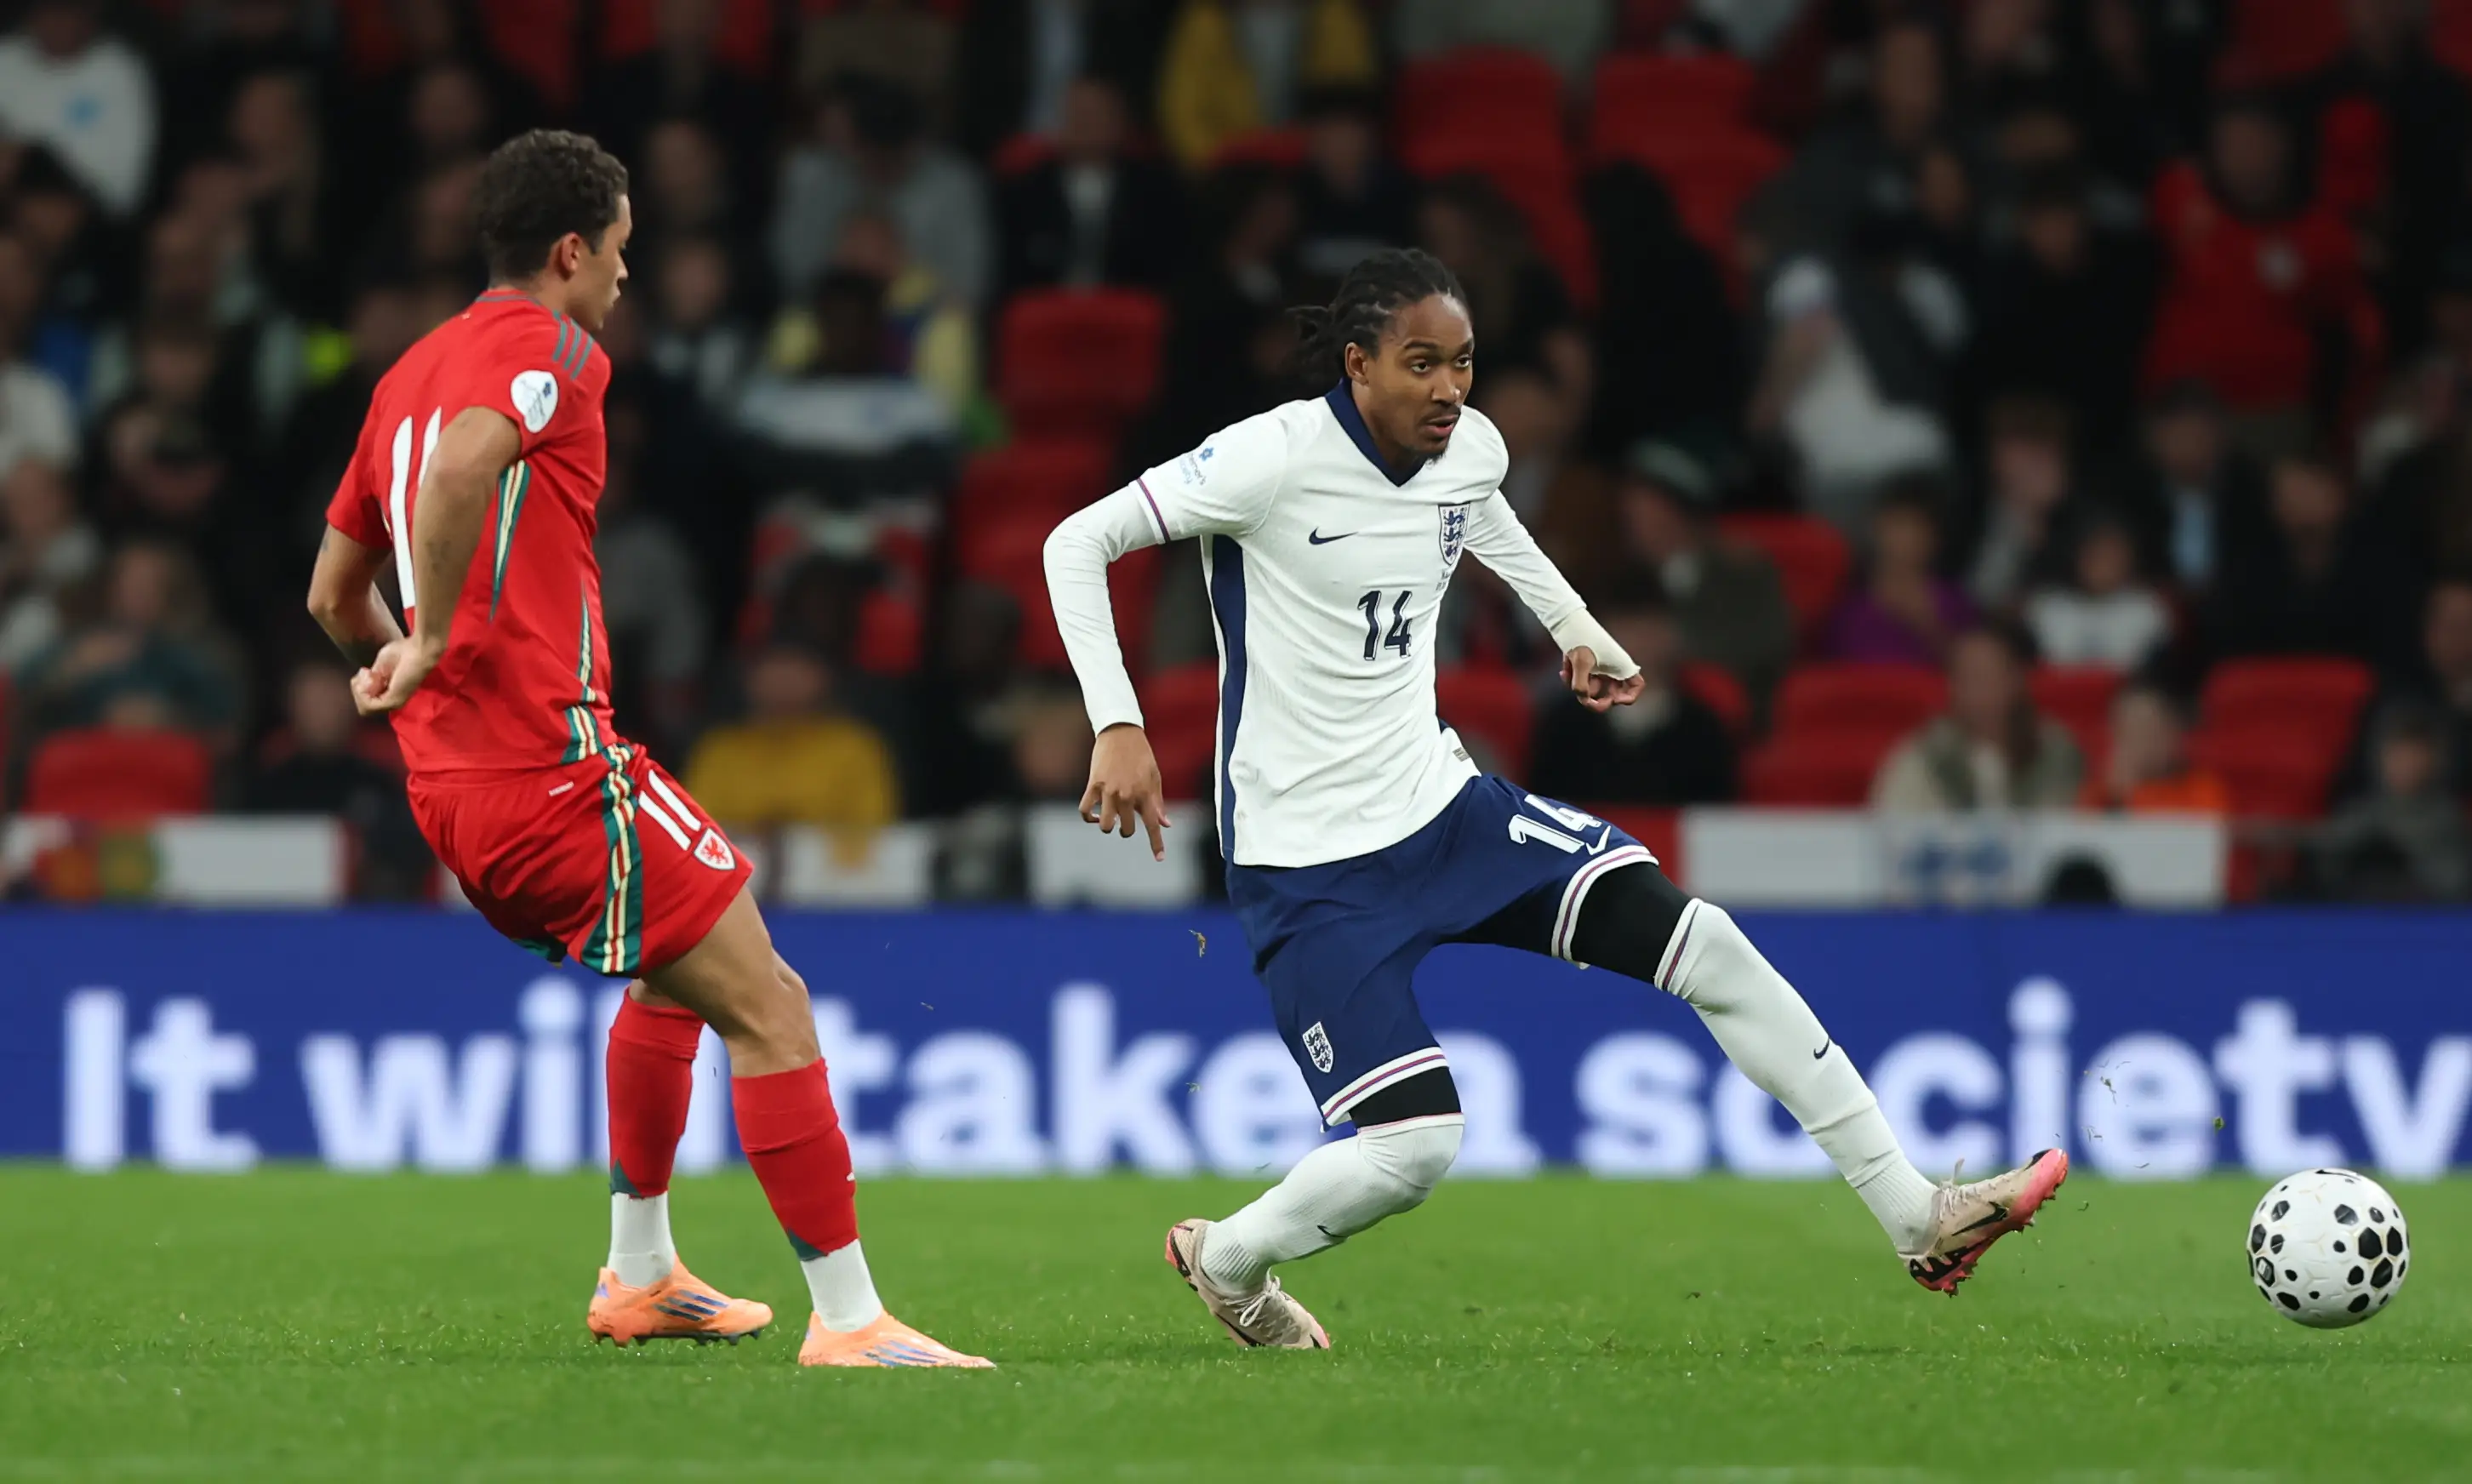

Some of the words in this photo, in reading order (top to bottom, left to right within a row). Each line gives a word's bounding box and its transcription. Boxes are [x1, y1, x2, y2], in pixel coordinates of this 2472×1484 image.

[1357, 590, 1413, 661] 14
[639, 769, 701, 851] 11
[1508, 794, 1601, 854] 14
[64, 987, 258, 1172] It
